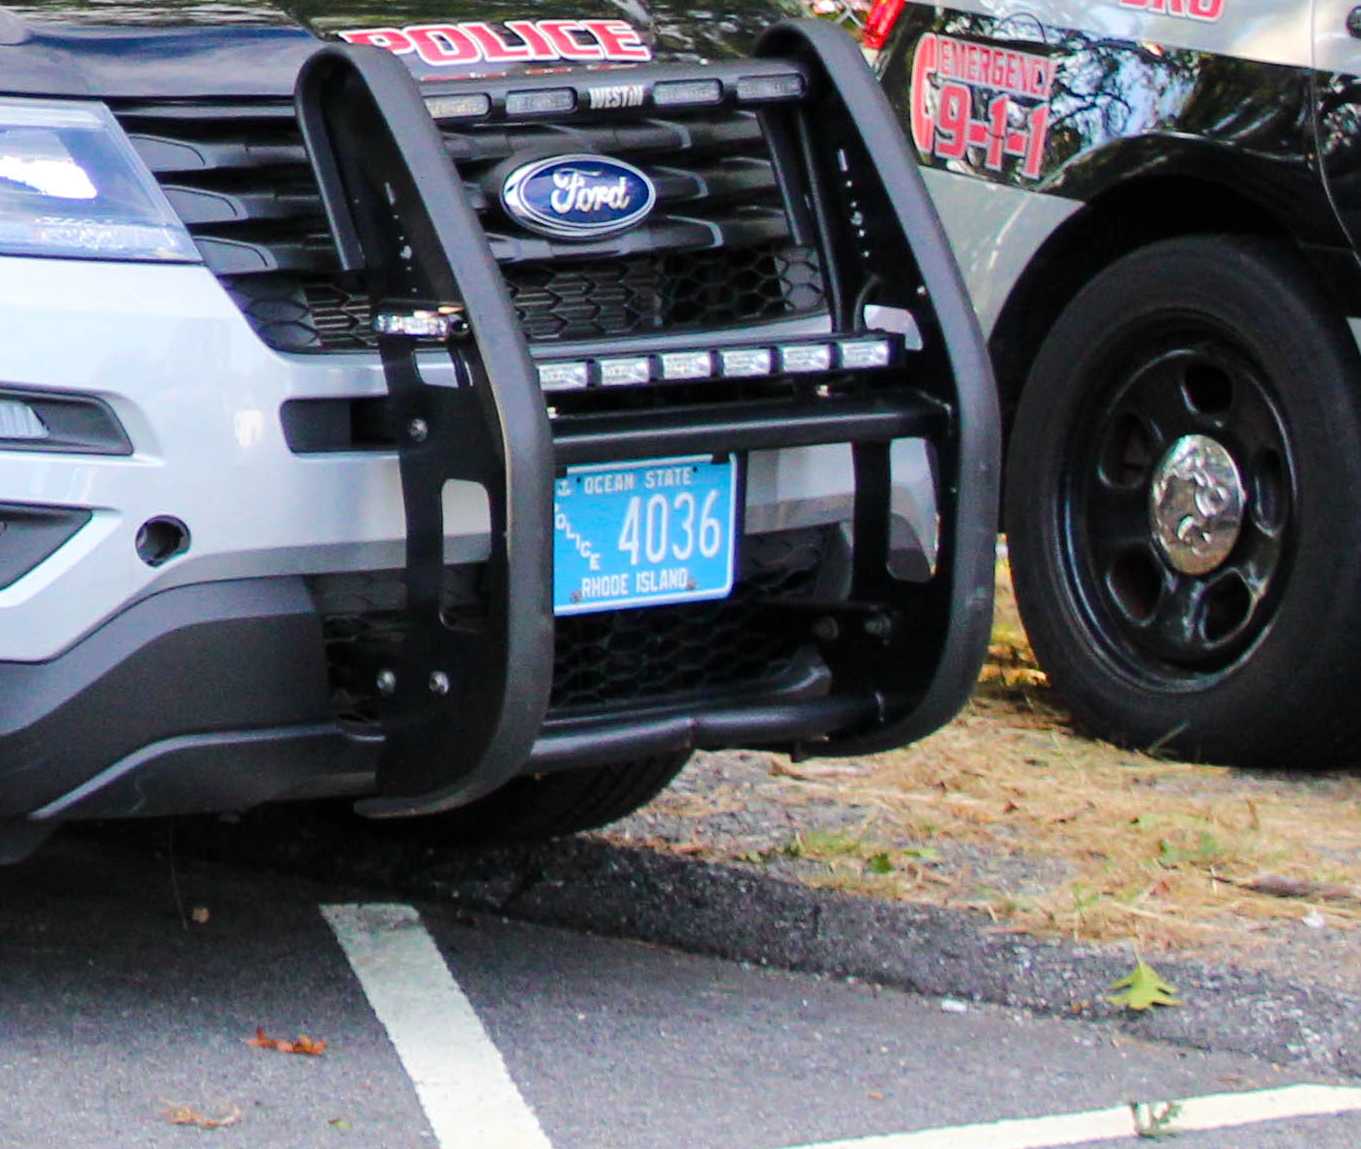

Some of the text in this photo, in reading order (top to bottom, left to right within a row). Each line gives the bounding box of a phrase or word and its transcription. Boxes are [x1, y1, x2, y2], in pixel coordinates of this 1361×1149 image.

[934, 82, 1050, 181] 9-1-1
[550, 168, 632, 214] Ford
[583, 466, 693, 496] OCEAN STATE
[555, 502, 602, 571] OLICE
[618, 489, 722, 566] 4036
[581, 567, 690, 599] RHODE ISLAND
